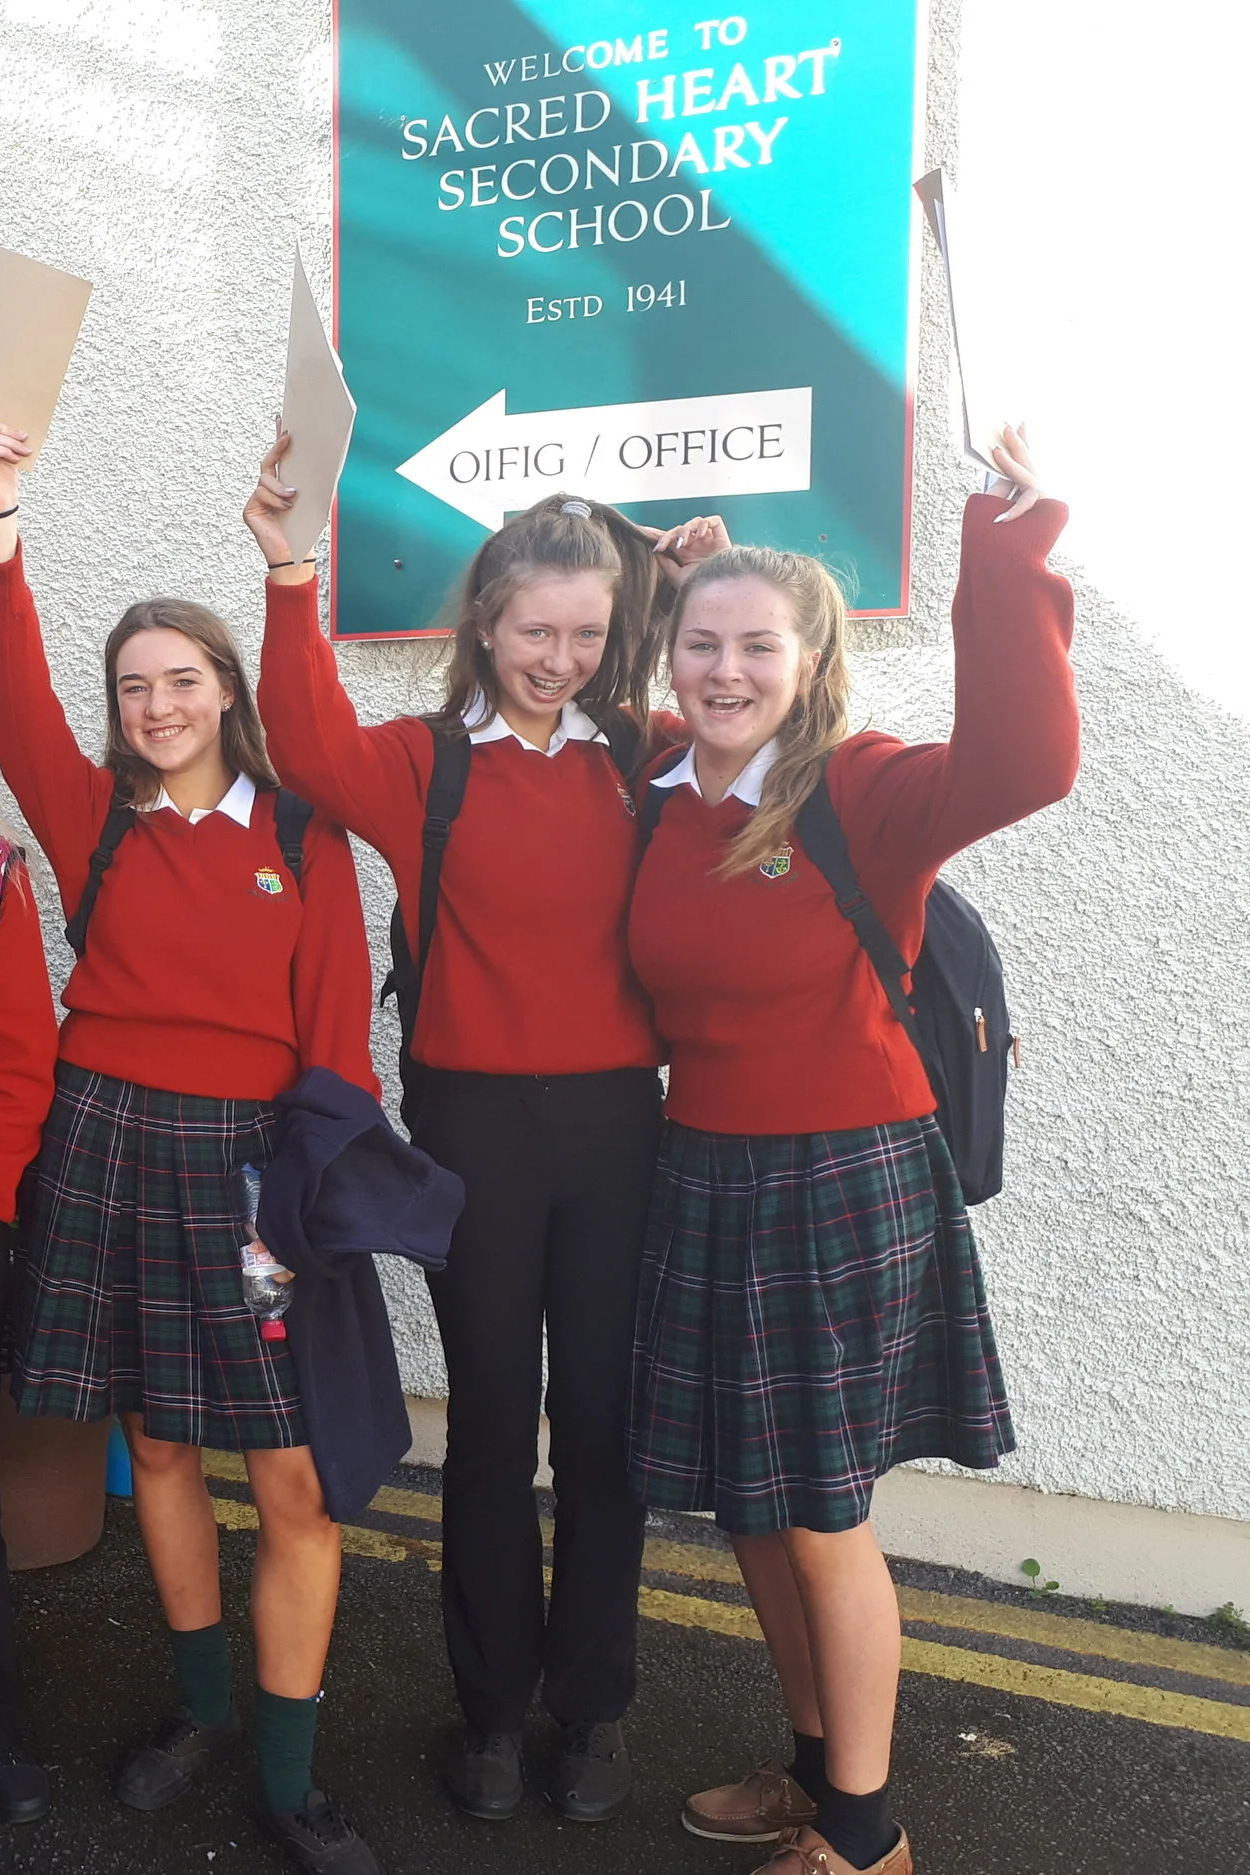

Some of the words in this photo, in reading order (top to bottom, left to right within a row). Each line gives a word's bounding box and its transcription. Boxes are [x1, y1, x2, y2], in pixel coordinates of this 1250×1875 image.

[483, 29, 669, 87] WELCOME
[694, 15, 748, 51] TO
[400, 89, 611, 161] SACRED
[635, 46, 836, 124] HEART
[437, 116, 790, 211] SECONDARY
[496, 188, 732, 258] SCHOOL
[525, 294, 604, 325] ESTD
[626, 279, 687, 314] 1941
[449, 442, 566, 485] OIFIG
[618, 423, 786, 471] OFFICE
